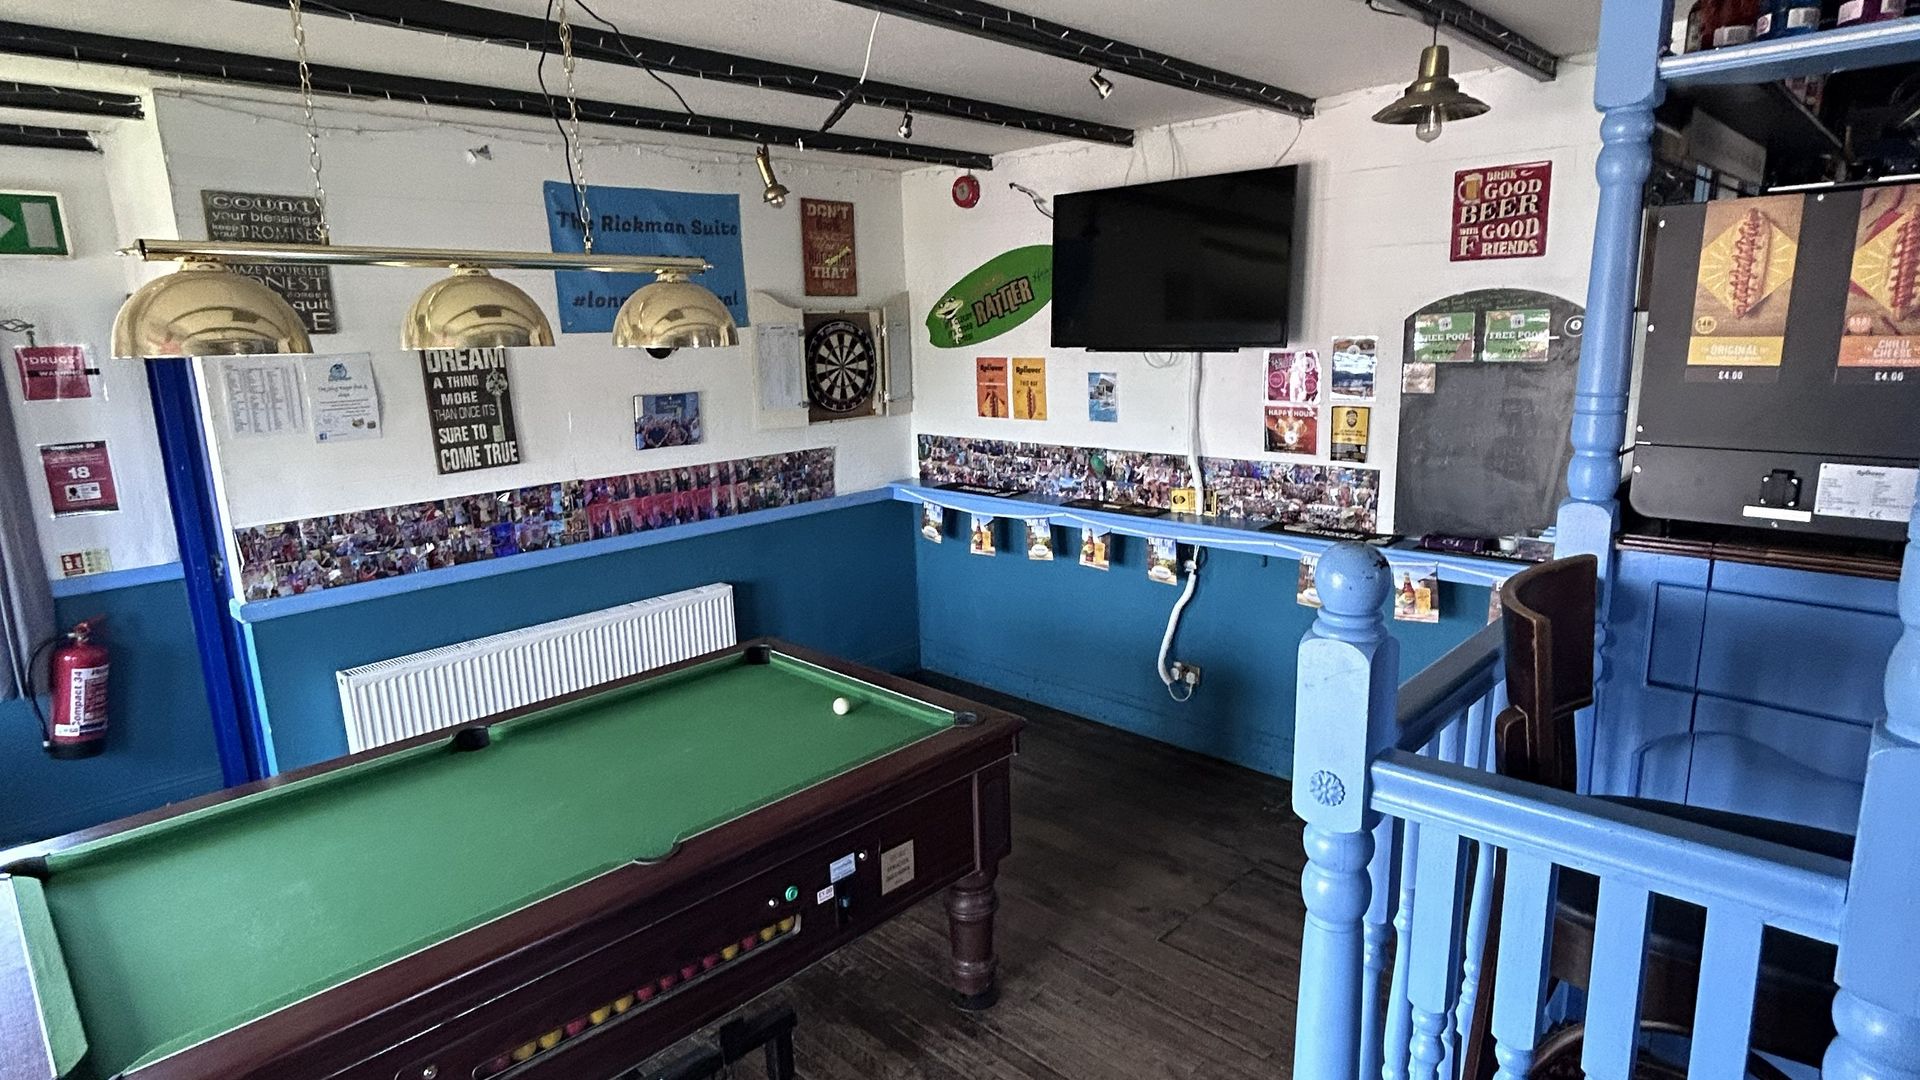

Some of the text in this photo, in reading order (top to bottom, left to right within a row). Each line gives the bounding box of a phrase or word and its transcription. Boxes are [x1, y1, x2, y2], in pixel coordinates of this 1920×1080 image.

[1484, 179, 1542, 200] GOOD
[212, 211, 247, 221] your
[1459, 194, 1539, 225] BEER
[601, 214, 687, 235] Rickman
[690, 218, 739, 236] Suite
[1481, 217, 1540, 240] GOOD
[241, 226, 322, 241] PROMISES
[265, 266, 327, 277] YOURSELF
[811, 266, 850, 280] THAT
[292, 300, 330, 312] quit
[972, 276, 1034, 327] RATTLER
[1445, 332, 1470, 341] POOL
[1489, 330, 1543, 341] FREE POO
[1710, 343, 1758, 356] ORIGINAL
[424, 348, 505, 373] DREAM
[433, 373, 479, 389] A THING
[1717, 370, 1744, 381] £4.00
[1874, 371, 1904, 382] £4.00
[440, 390, 478, 406] MORE
[432, 407, 458, 421] THAN
[459, 405, 480, 419] ONCE
[438, 423, 488, 444] SURE TO
[440, 440, 517, 471] COME TRUE
[67, 466, 91, 480] 18
[73, 671, 83, 683] 34
